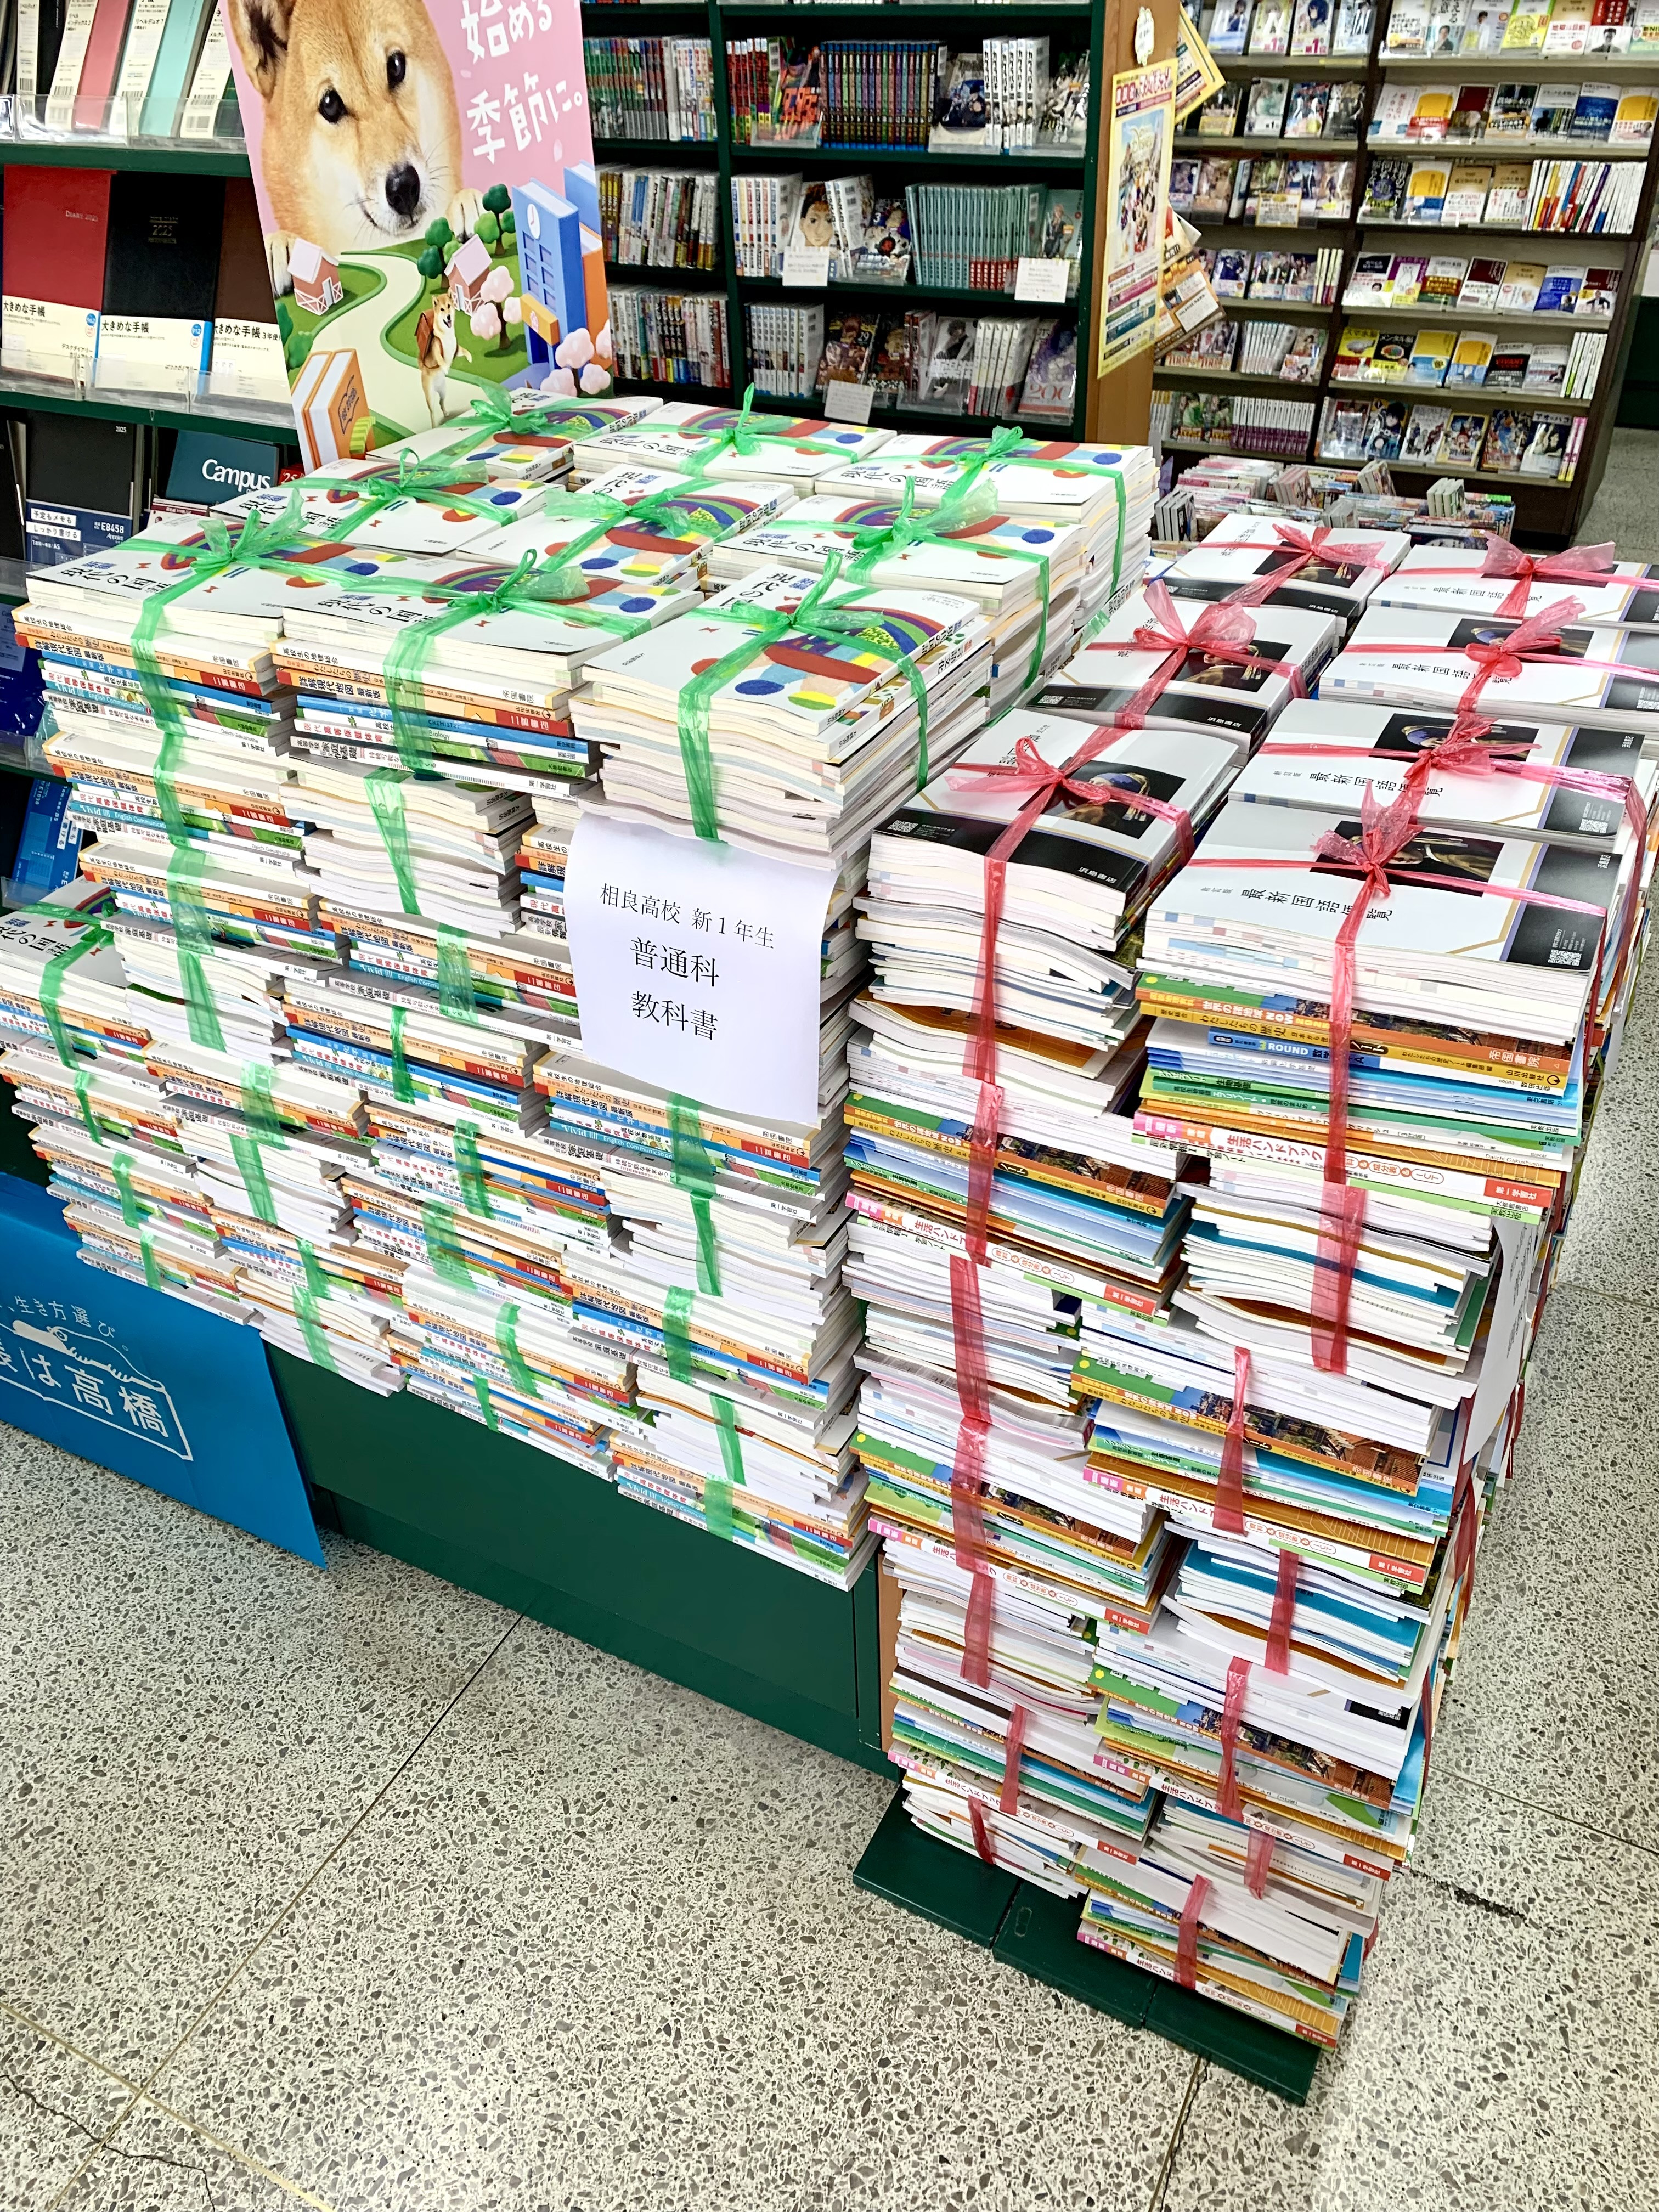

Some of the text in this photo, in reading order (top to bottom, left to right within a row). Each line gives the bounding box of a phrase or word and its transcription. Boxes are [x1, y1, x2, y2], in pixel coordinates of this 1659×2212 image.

[461, 0, 553, 64] 始める
[467, 71, 583, 164] 季節に。
[4, 301, 46, 317] 大きめな手帳
[102, 321, 149, 334] 大きめな手帳
[202, 459, 270, 492] Campus
[33, 511, 72, 524] 予定もメモも
[238, 499, 342, 530] 現代国語
[34, 525, 77, 539] しっかり書ける
[101, 523, 124, 533] E8458
[720, 572, 797, 609] 現代の国
[1433, 586, 1542, 602] 最新国語覧
[213, 655, 239, 668] 帝国書院
[283, 647, 338, 664] 高校生の地理総合
[313, 663, 371, 682] わたしたちの歴史
[1392, 663, 1512, 685] 最新国語覧
[299, 676, 381, 699] 詳解現代地図 最新版
[503, 690, 534, 704] 帝国書院
[428, 730, 450, 740] Biology
[80, 804, 101, 815] Vivid
[600, 883, 681, 925] 相良高校
[332, 906, 383, 924] 高校生の地理総合
[630, 936, 719, 987] 普通科
[360, 963, 417, 984] Vivid English
[631, 991, 718, 1041] 教科書
[1266, 1012, 1294, 1024] NOW
[1199, 1015, 1286, 1037] わたしたちの歴史
[1489, 1049, 1541, 1068] 帝国書院
[547, 1071, 602, 1091] 高校生の地理総合
[1506, 1069, 1544, 1082] 山川出版社
[561, 1125, 673, 1159] Vivid English Communication
[1227, 1135, 1323, 1160] 生活ハンドブック
[1485, 1154, 1544, 1167] Daiichi Gakushusha
[1495, 1186, 1537, 1200] 第一学習社
[0, 1296, 128, 1351] 、生き方選び。
